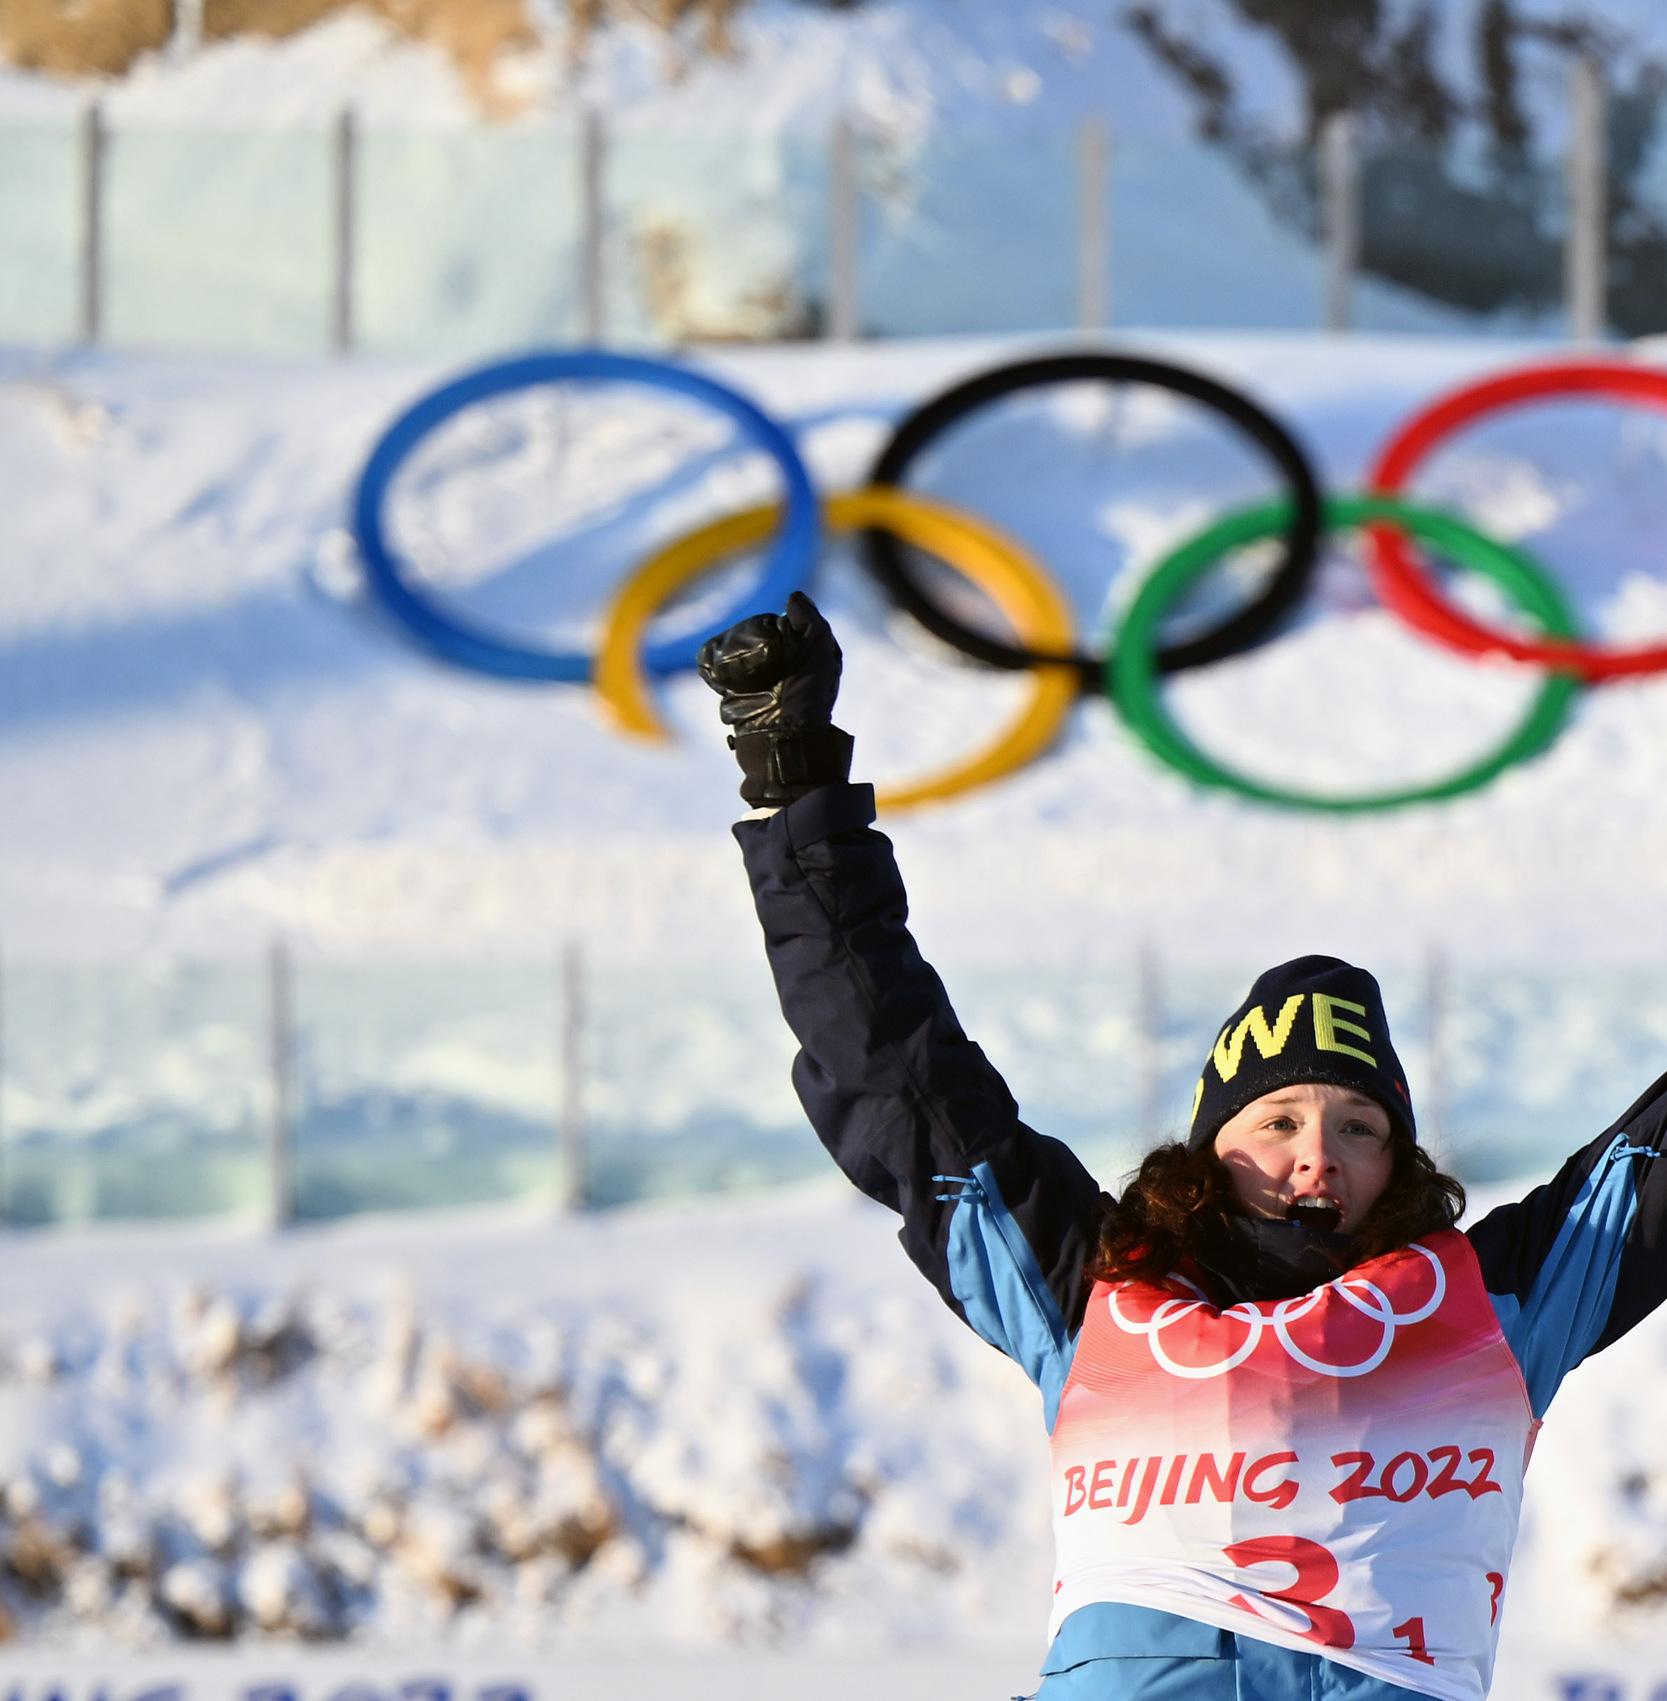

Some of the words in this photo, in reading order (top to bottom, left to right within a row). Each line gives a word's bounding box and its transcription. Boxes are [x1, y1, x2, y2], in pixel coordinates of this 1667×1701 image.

[1190, 992, 1377, 1131] WE
[1064, 1452, 1299, 1525] BEIJING
[1328, 1446, 1503, 1504] 2022
[1222, 1536, 1356, 1649] 3
[1392, 1617, 1435, 1665] 1
